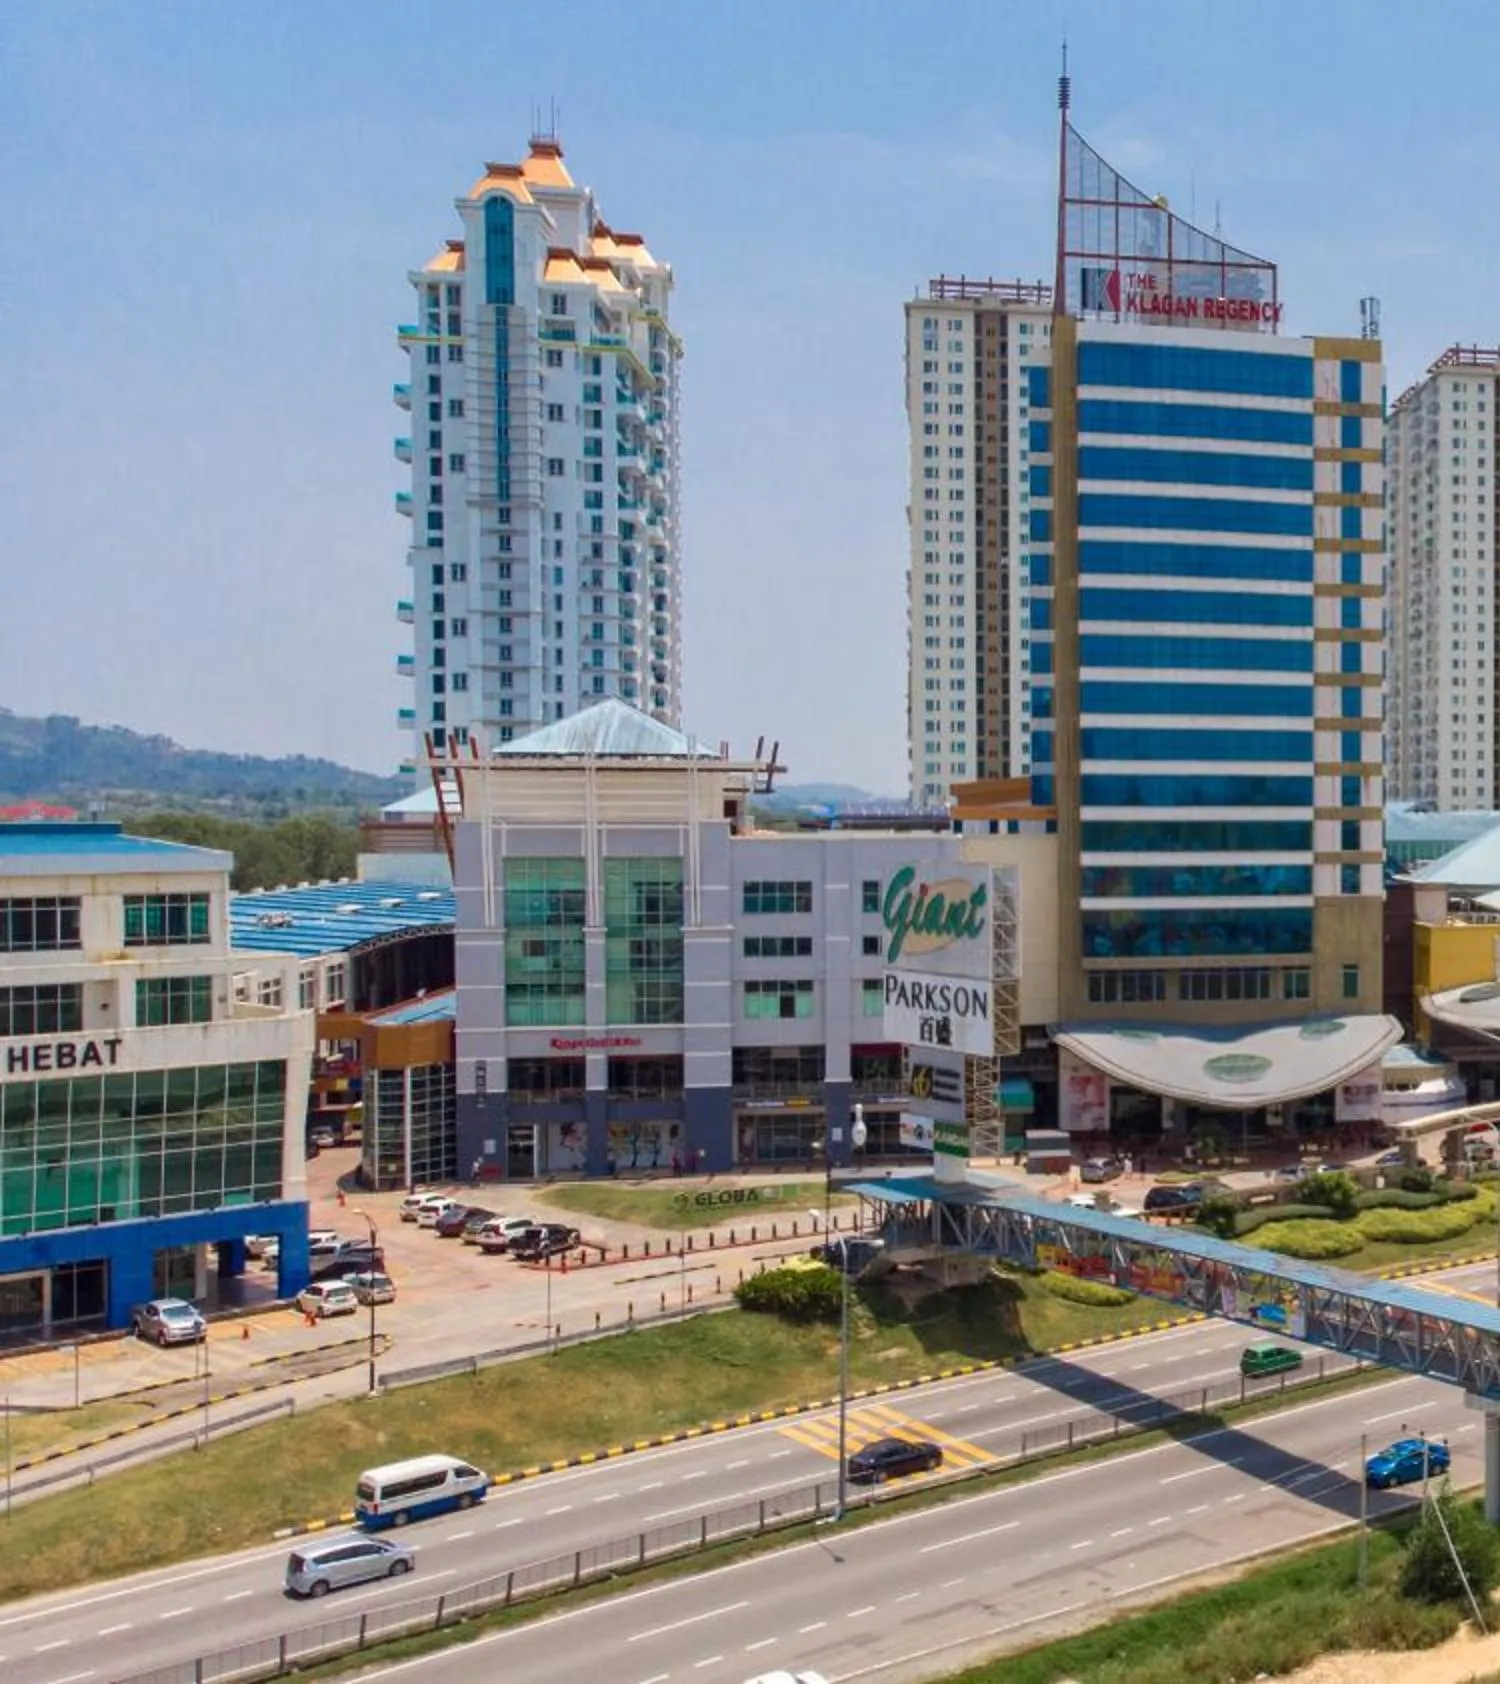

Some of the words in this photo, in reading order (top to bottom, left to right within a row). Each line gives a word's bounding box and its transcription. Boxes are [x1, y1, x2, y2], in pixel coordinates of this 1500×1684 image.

[1128, 272, 1157, 290] THE
[1126, 291, 1197, 318] KLAGAN
[1204, 297, 1283, 323] REGENCY
[883, 866, 986, 964] Giant
[885, 974, 988, 1020] PARKSON
[8, 1038, 122, 1073] HEBAT
